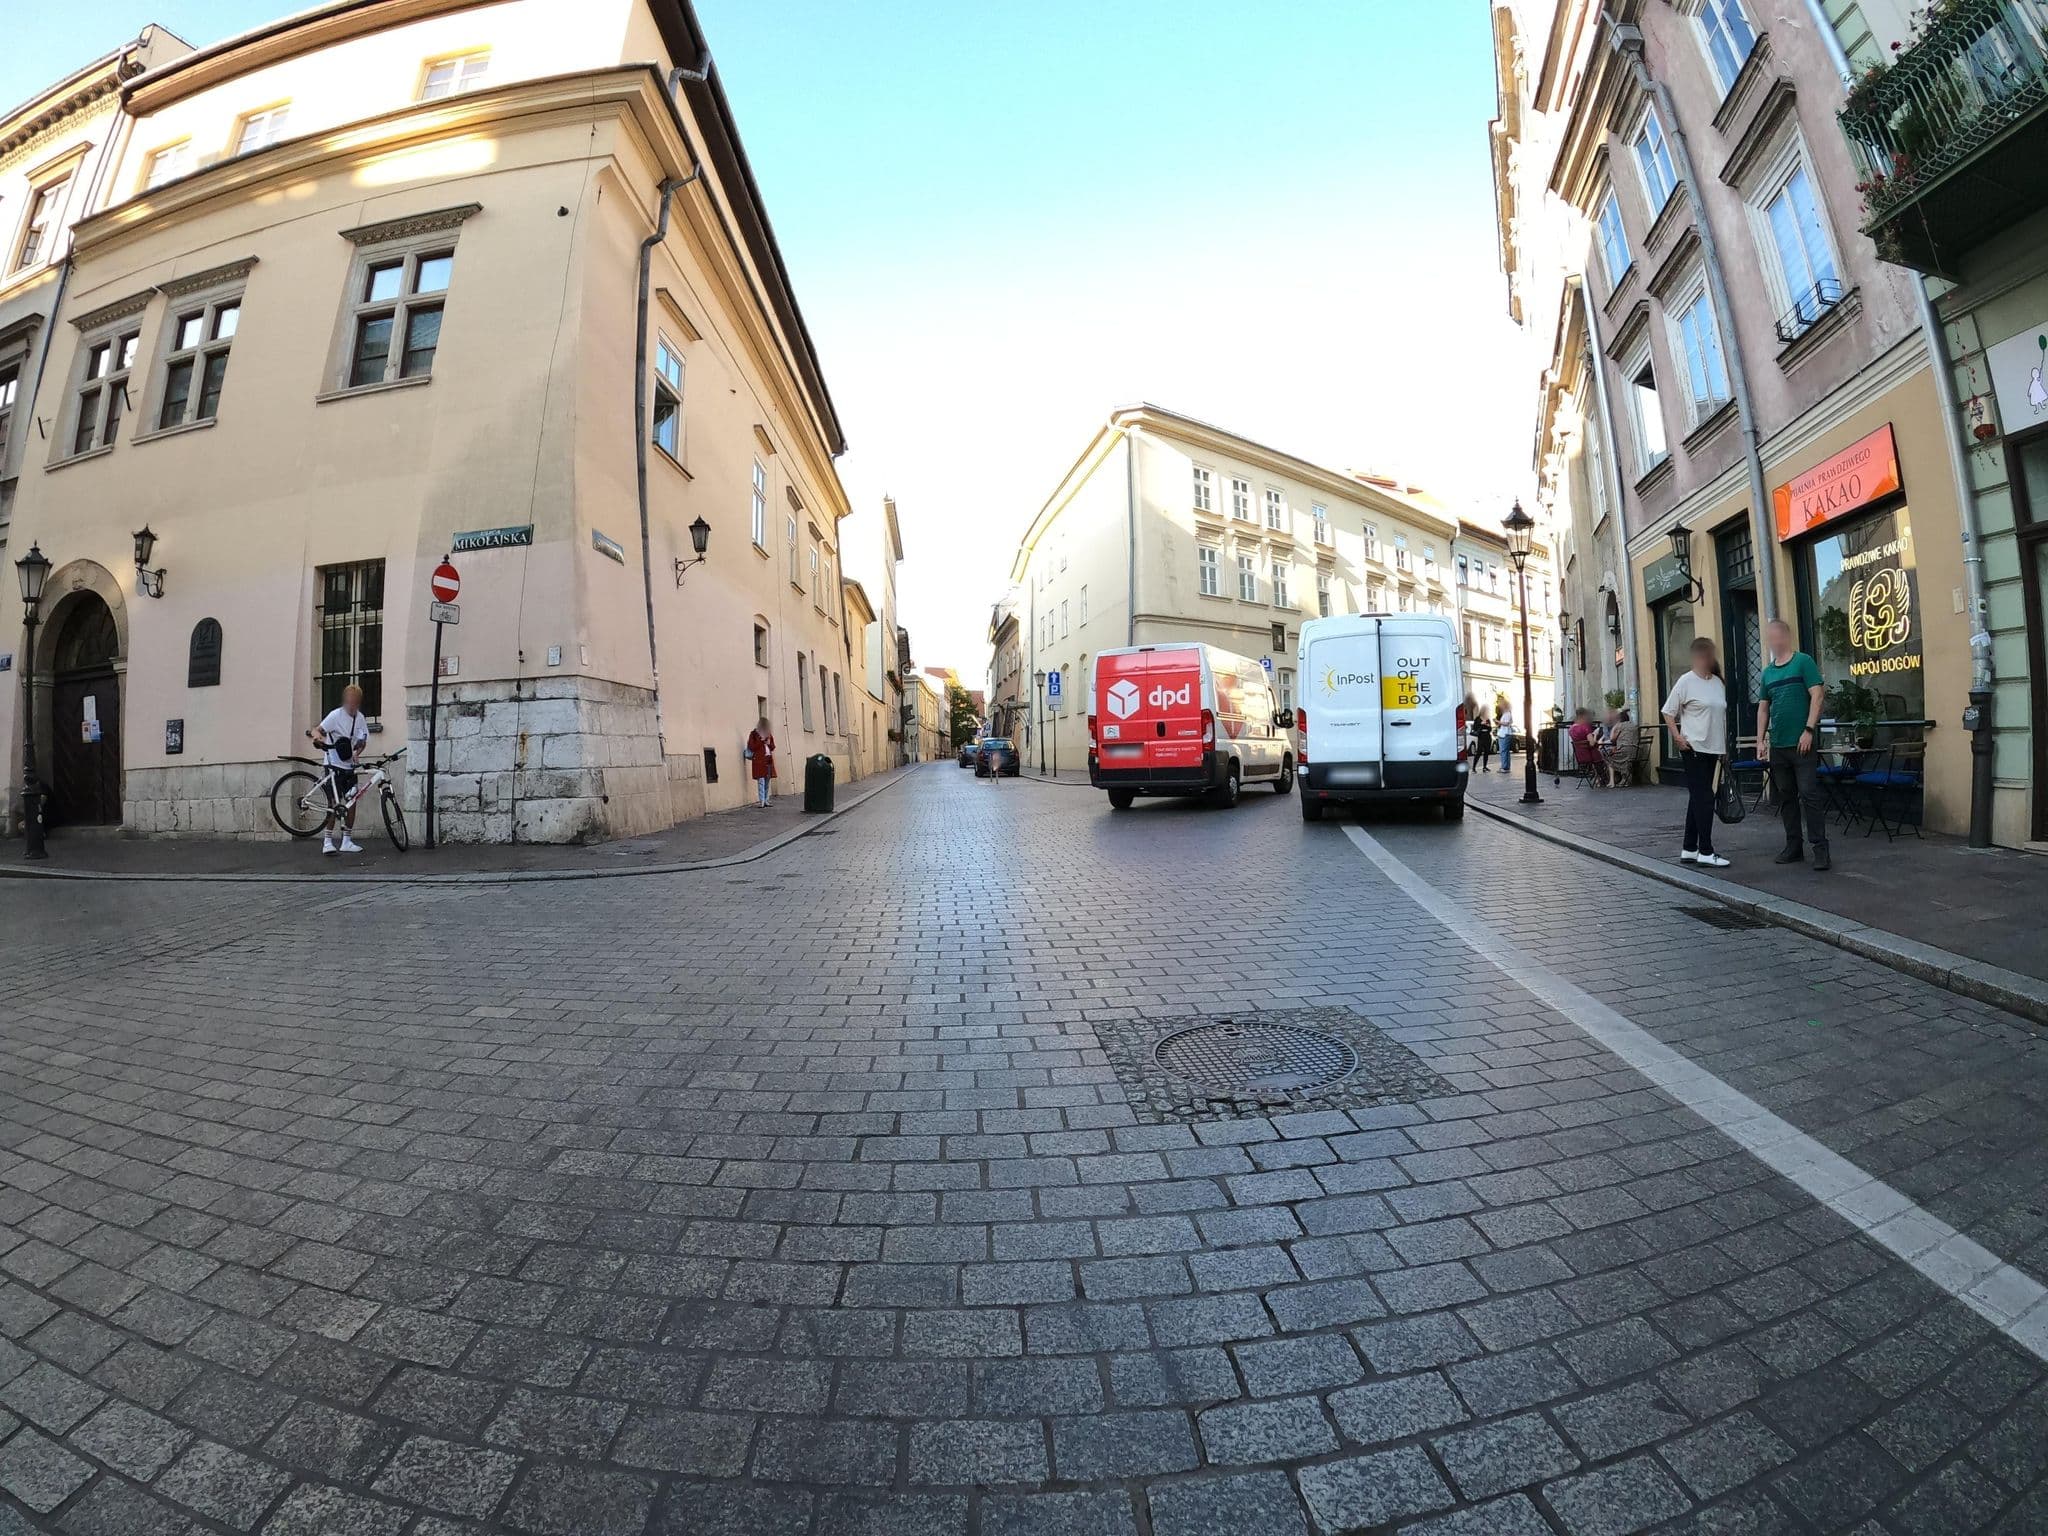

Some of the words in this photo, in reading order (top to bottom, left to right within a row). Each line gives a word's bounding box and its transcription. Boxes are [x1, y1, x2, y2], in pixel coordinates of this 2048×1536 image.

[1818, 447, 1871, 483] PRAWDZIWEGO
[1803, 474, 1862, 522] KAKAO
[454, 532, 527, 550] MIKOŁAJSKA
[1841, 546, 1882, 572] PRAWDZIWE
[1883, 536, 1908, 558] KAKAO
[1397, 657, 1431, 668] OUT
[1850, 657, 1880, 676] NAPÓJ
[1881, 651, 1921, 671] BOGÓW
[1336, 672, 1375, 686] InPost
[1397, 670, 1420, 680] OF
[1051, 684, 1059, 695] P
[1397, 682, 1431, 692] THE
[1148, 682, 1190, 711] dpd
[1398, 694, 1432, 705] BOX
